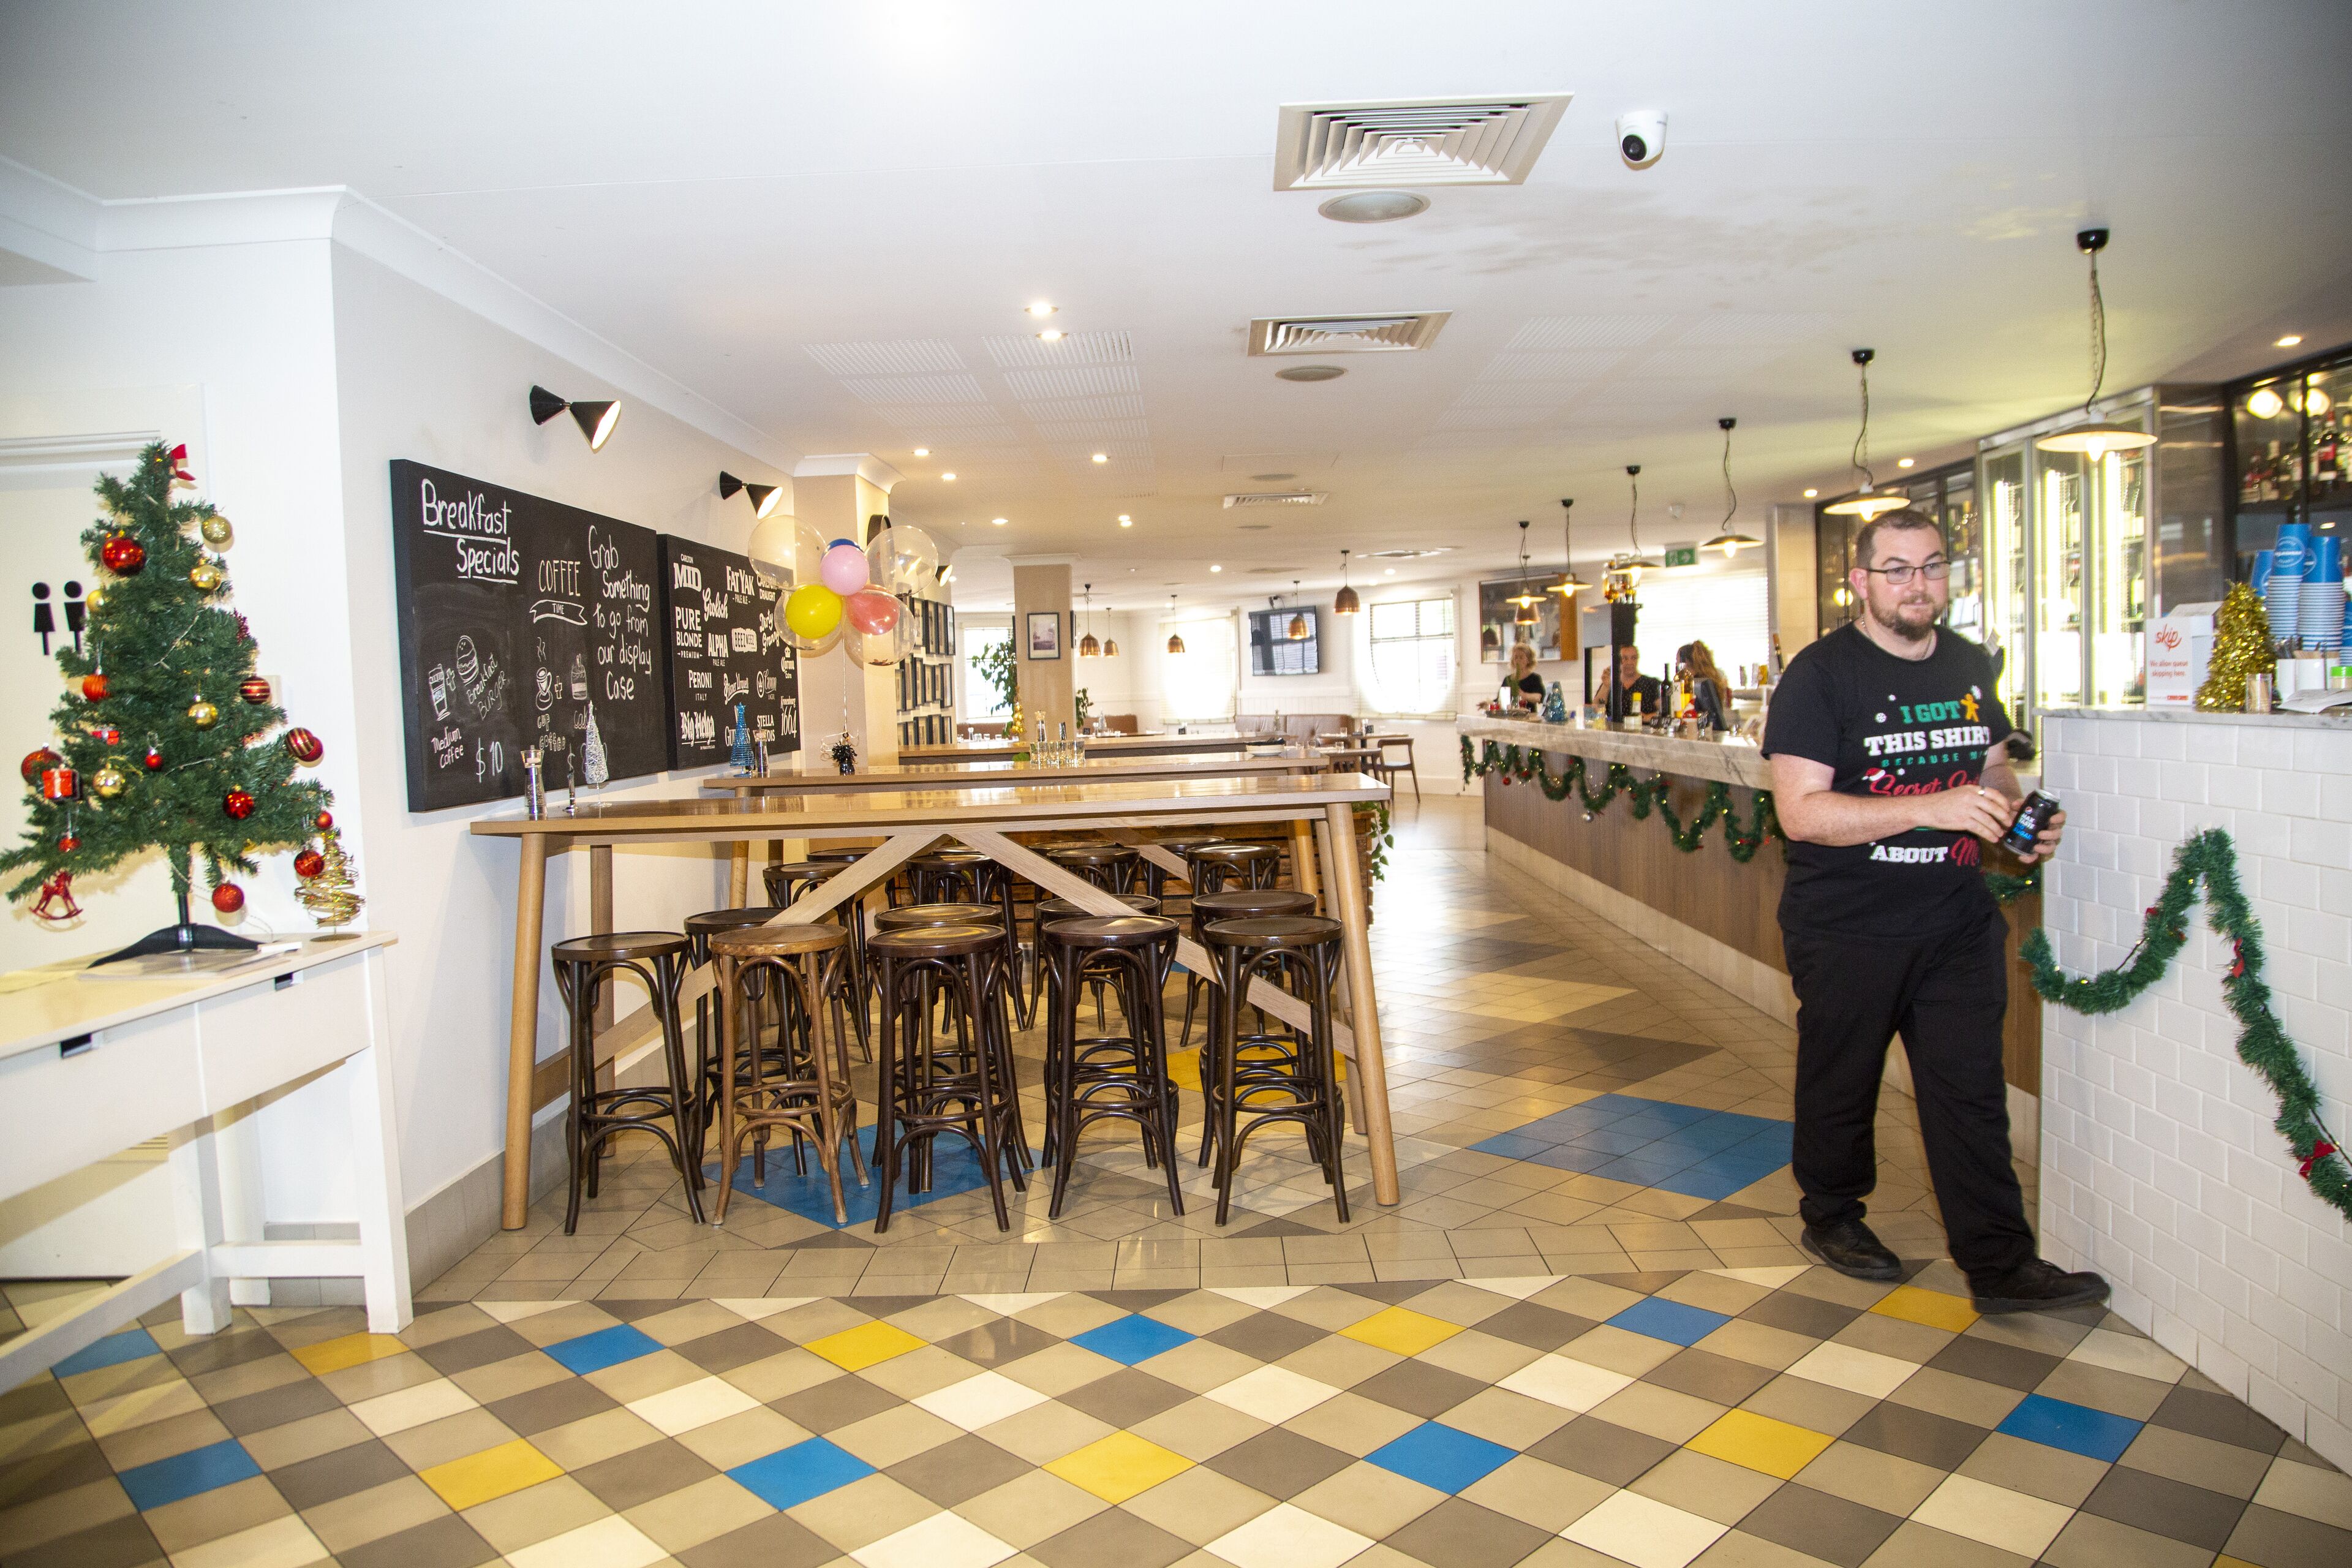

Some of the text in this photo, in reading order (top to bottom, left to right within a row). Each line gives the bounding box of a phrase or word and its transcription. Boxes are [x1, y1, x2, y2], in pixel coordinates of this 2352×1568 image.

[421, 478, 512, 535] Breakfast
[456, 537, 520, 578] Specials
[589, 525, 619, 570] Grab
[680, 553, 694, 564] CARLTON
[538, 560, 581, 597] COFFEE
[673, 562, 702, 592] MID
[726, 565, 755, 596] FAT YAK
[603, 569, 650, 613] Something
[760, 588, 775, 602] DRAUGHT
[552, 603, 565, 615] TIME
[703, 587, 729, 622] Grolsch
[609, 611, 621, 640] go
[626, 604, 649, 638] from
[675, 606, 702, 631] PURE
[760, 609, 774, 633] Dirty
[676, 631, 703, 648] BLONDE
[707, 633, 729, 658] ALPHA
[734, 631, 746, 648] BEEZ
[763, 631, 780, 656] Granny
[2155, 624, 2183, 652] skip
[598, 633, 652, 676] our display
[680, 650, 700, 659] PREMIUM
[781, 656, 795, 673] Corona
[466, 652, 499, 705] Breakfast
[606, 670, 635, 701] Case
[688, 669, 712, 688] PERONI
[695, 693, 707, 701] ITALY
[573, 705, 589, 729] Cak
[756, 714, 774, 728] STELLA
[781, 705, 797, 739] 1664
[1900, 700, 1961, 724] I GOT
[680, 709, 715, 747] Big Helga
[1864, 731, 1927, 756] THIS
[489, 741, 503, 777] 10
[1881, 752, 1959, 767] BECAUSE
[1869, 845, 1949, 864] ABOUT
